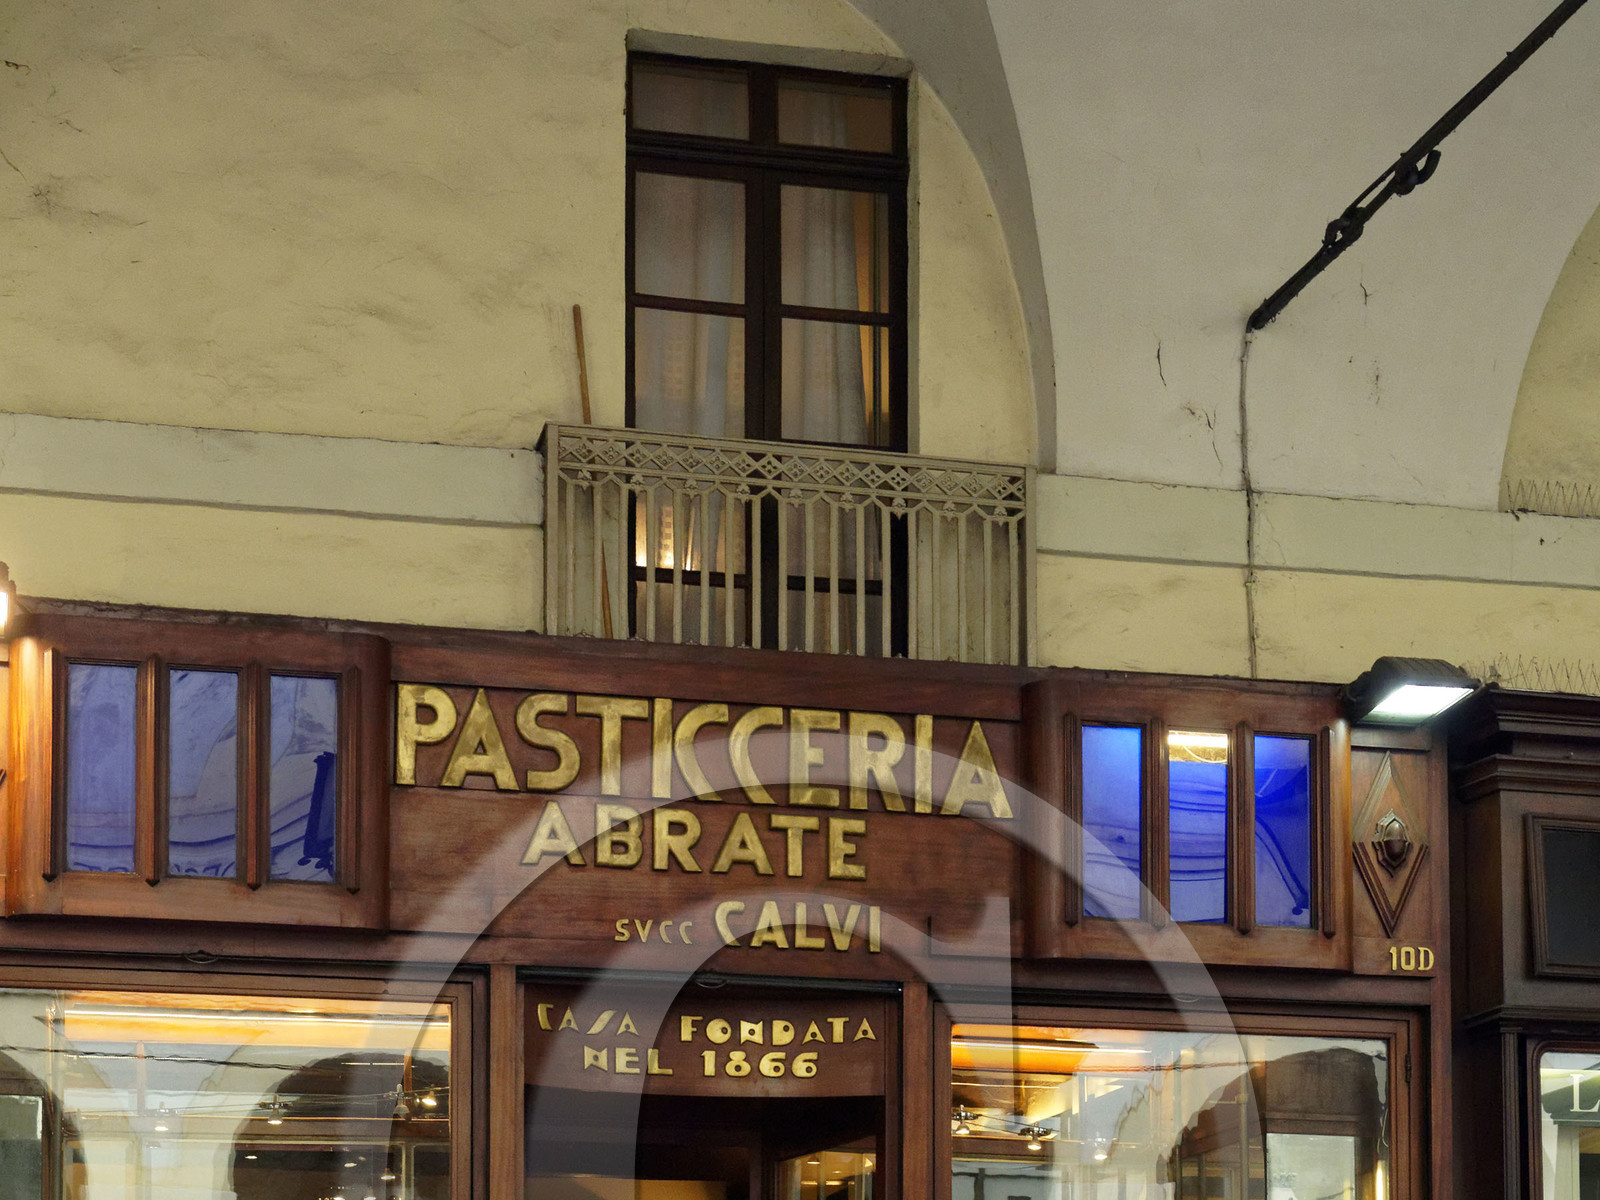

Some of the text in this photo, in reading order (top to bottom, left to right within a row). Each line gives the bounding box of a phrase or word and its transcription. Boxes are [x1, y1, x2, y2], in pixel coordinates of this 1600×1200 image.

[396, 682, 1013, 819] PASTICCERIA
[521, 800, 867, 881] ABRATE
[614, 900, 882, 952] SVCC CALVI
[1389, 946, 1435, 971] 10D
[537, 1003, 876, 1047] CASA FONDATA
[584, 1045, 818, 1077] NEL 1866
